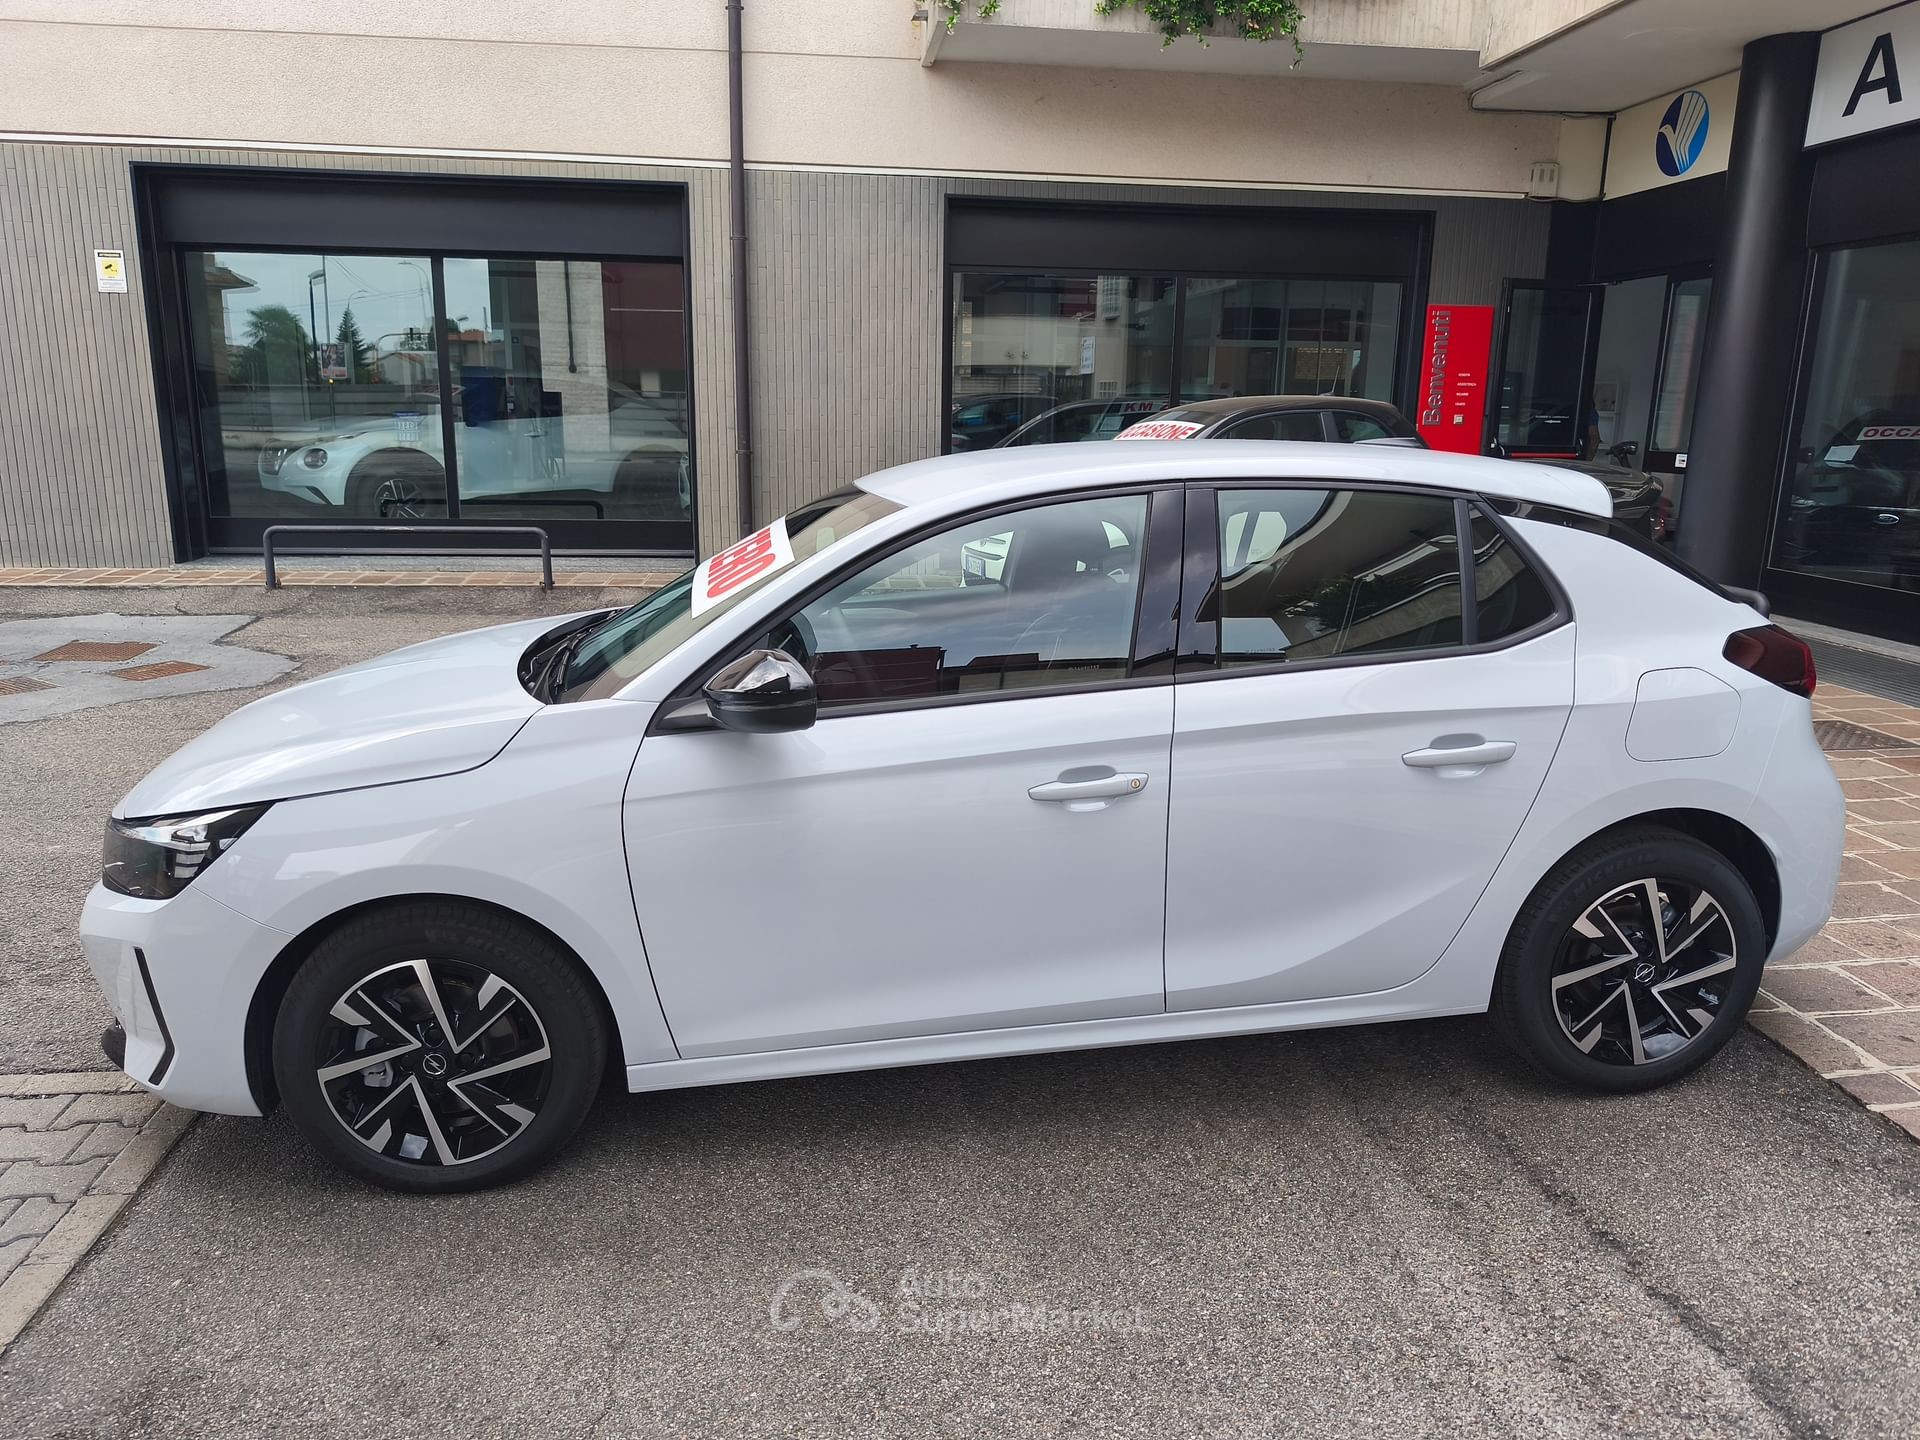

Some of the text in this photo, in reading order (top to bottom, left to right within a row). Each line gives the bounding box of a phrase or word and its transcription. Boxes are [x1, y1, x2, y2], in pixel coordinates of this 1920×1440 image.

[1842, 32, 1902, 117] A
[1422, 310, 1450, 425] Benvenuti
[1124, 402, 1153, 412] KM
[707, 527, 776, 598] ZERO
